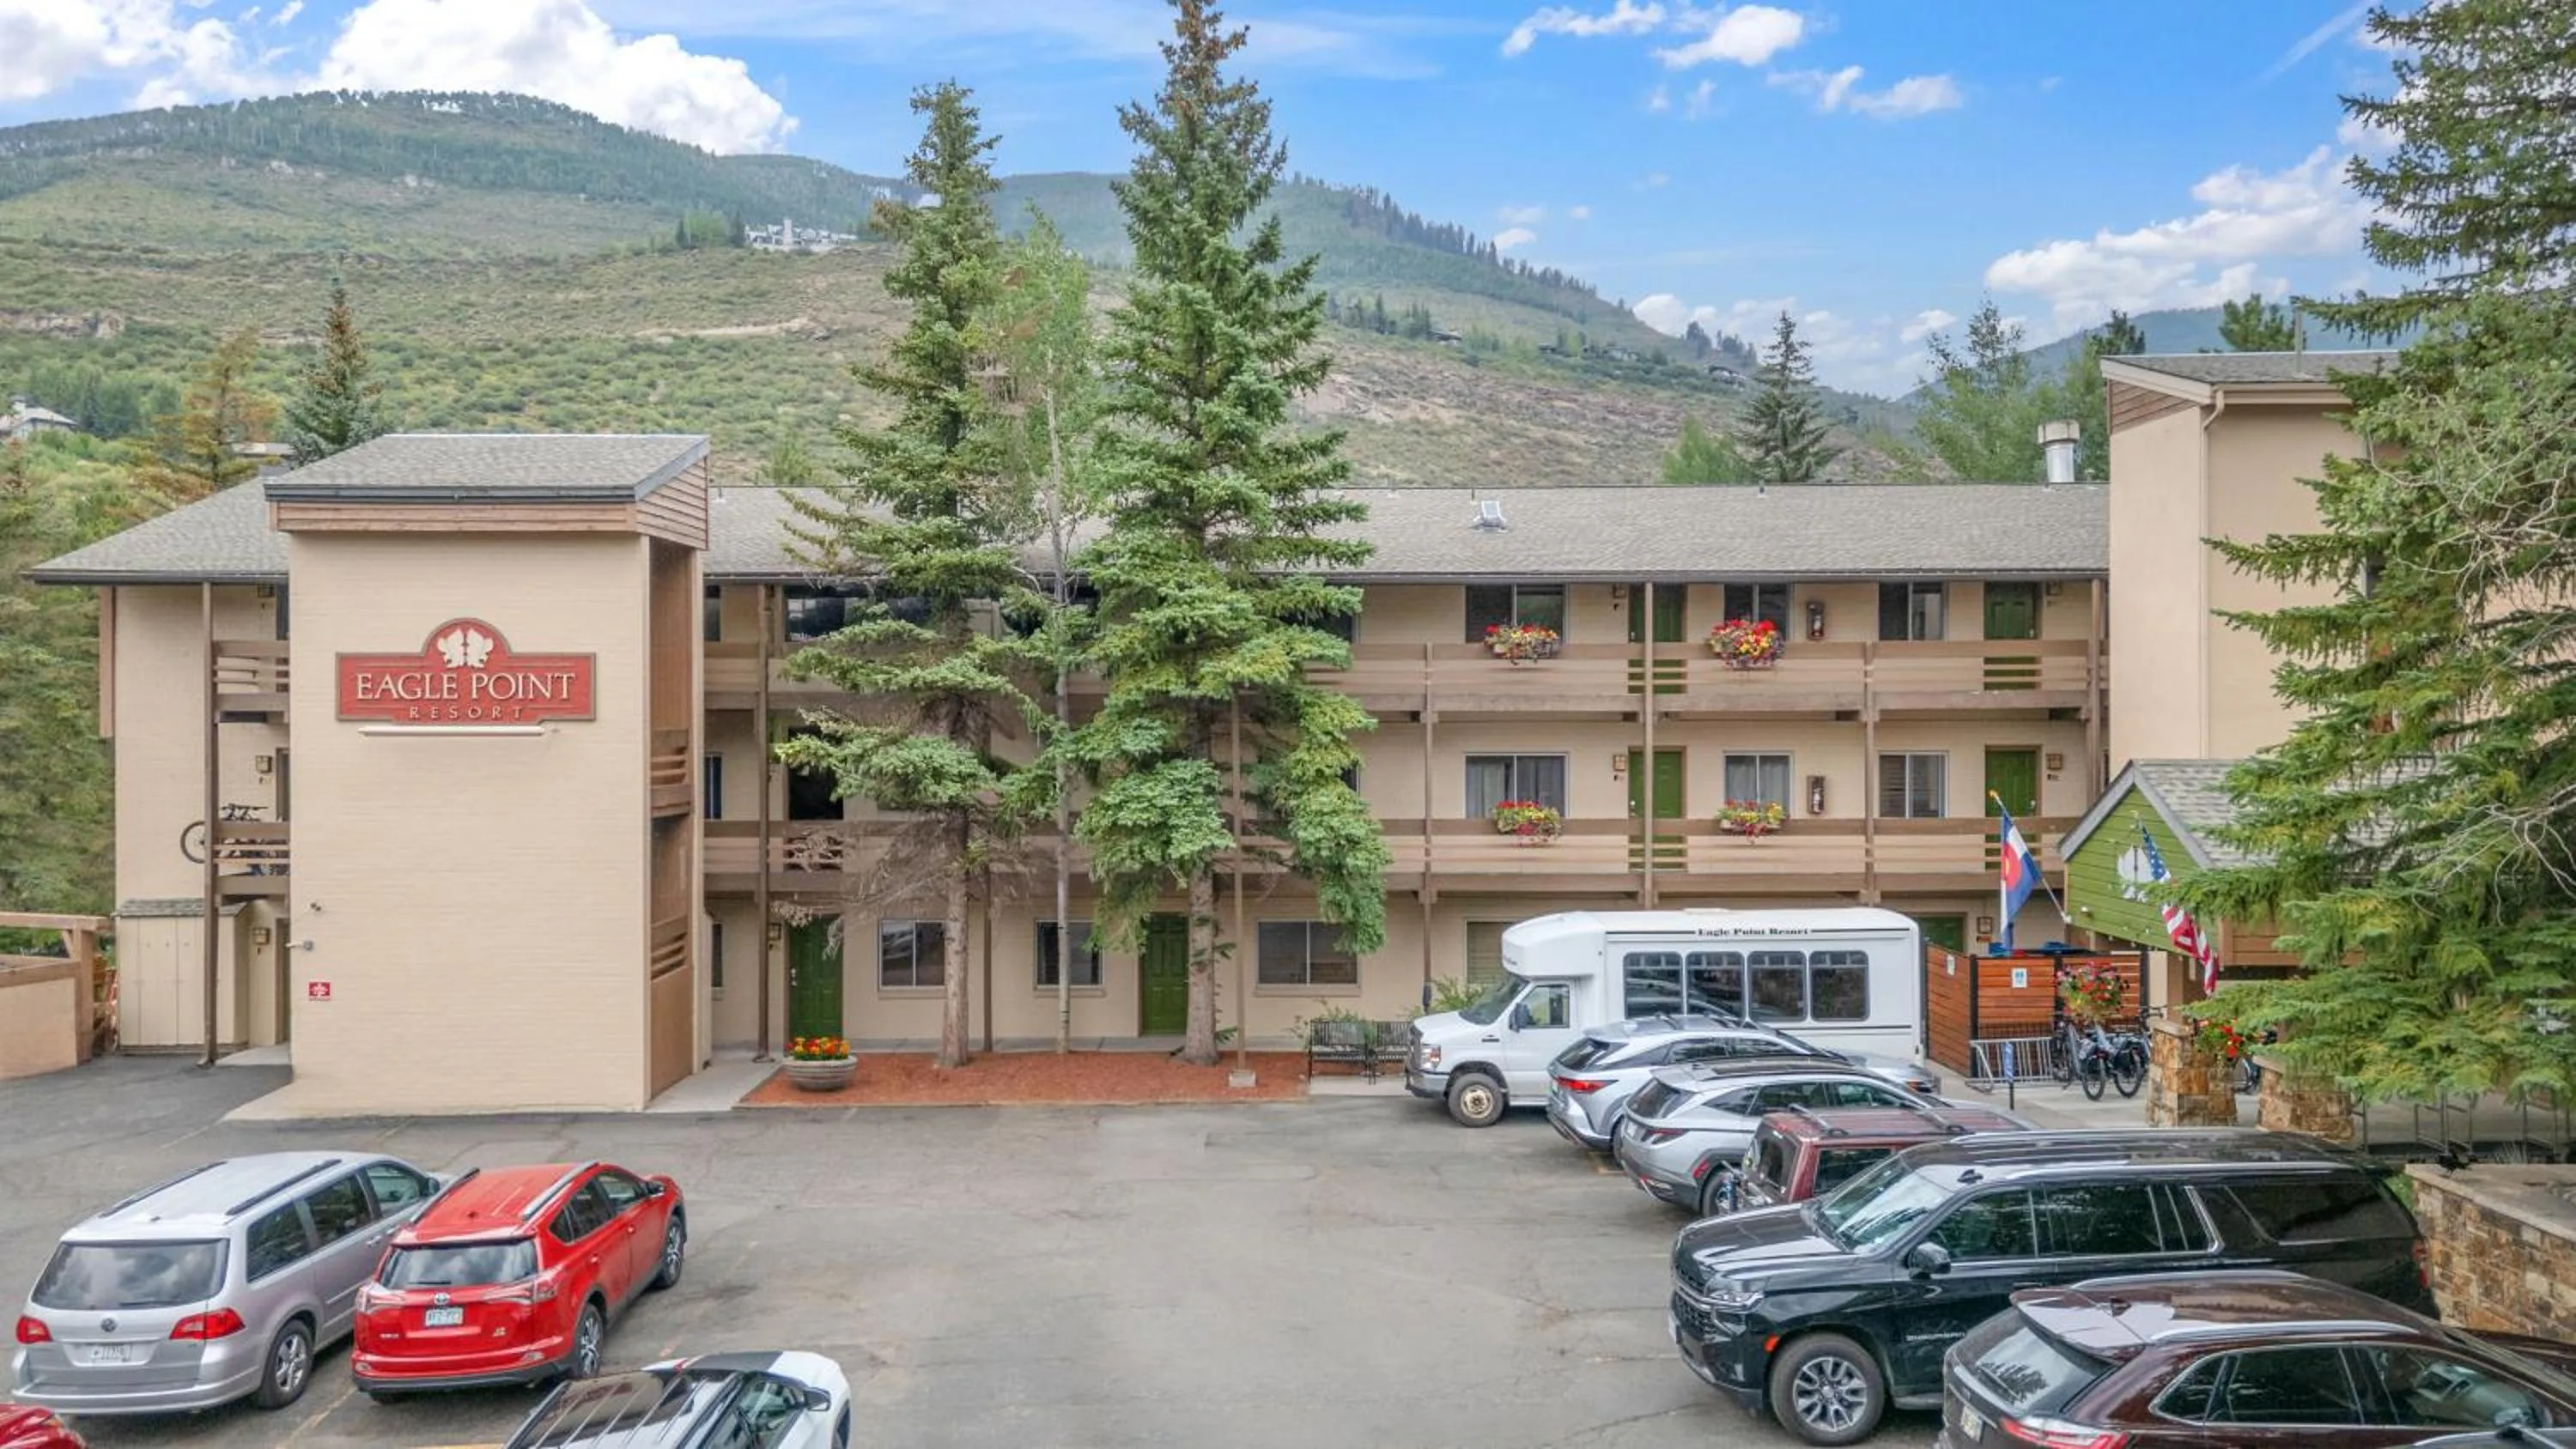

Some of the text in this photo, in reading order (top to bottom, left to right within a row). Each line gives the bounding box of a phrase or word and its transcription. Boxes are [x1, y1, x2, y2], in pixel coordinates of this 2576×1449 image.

[355, 672, 576, 700] EAGLE POINT
[409, 706, 525, 719] RESORT
[1697, 927, 1808, 937] Eagle Point Resort
